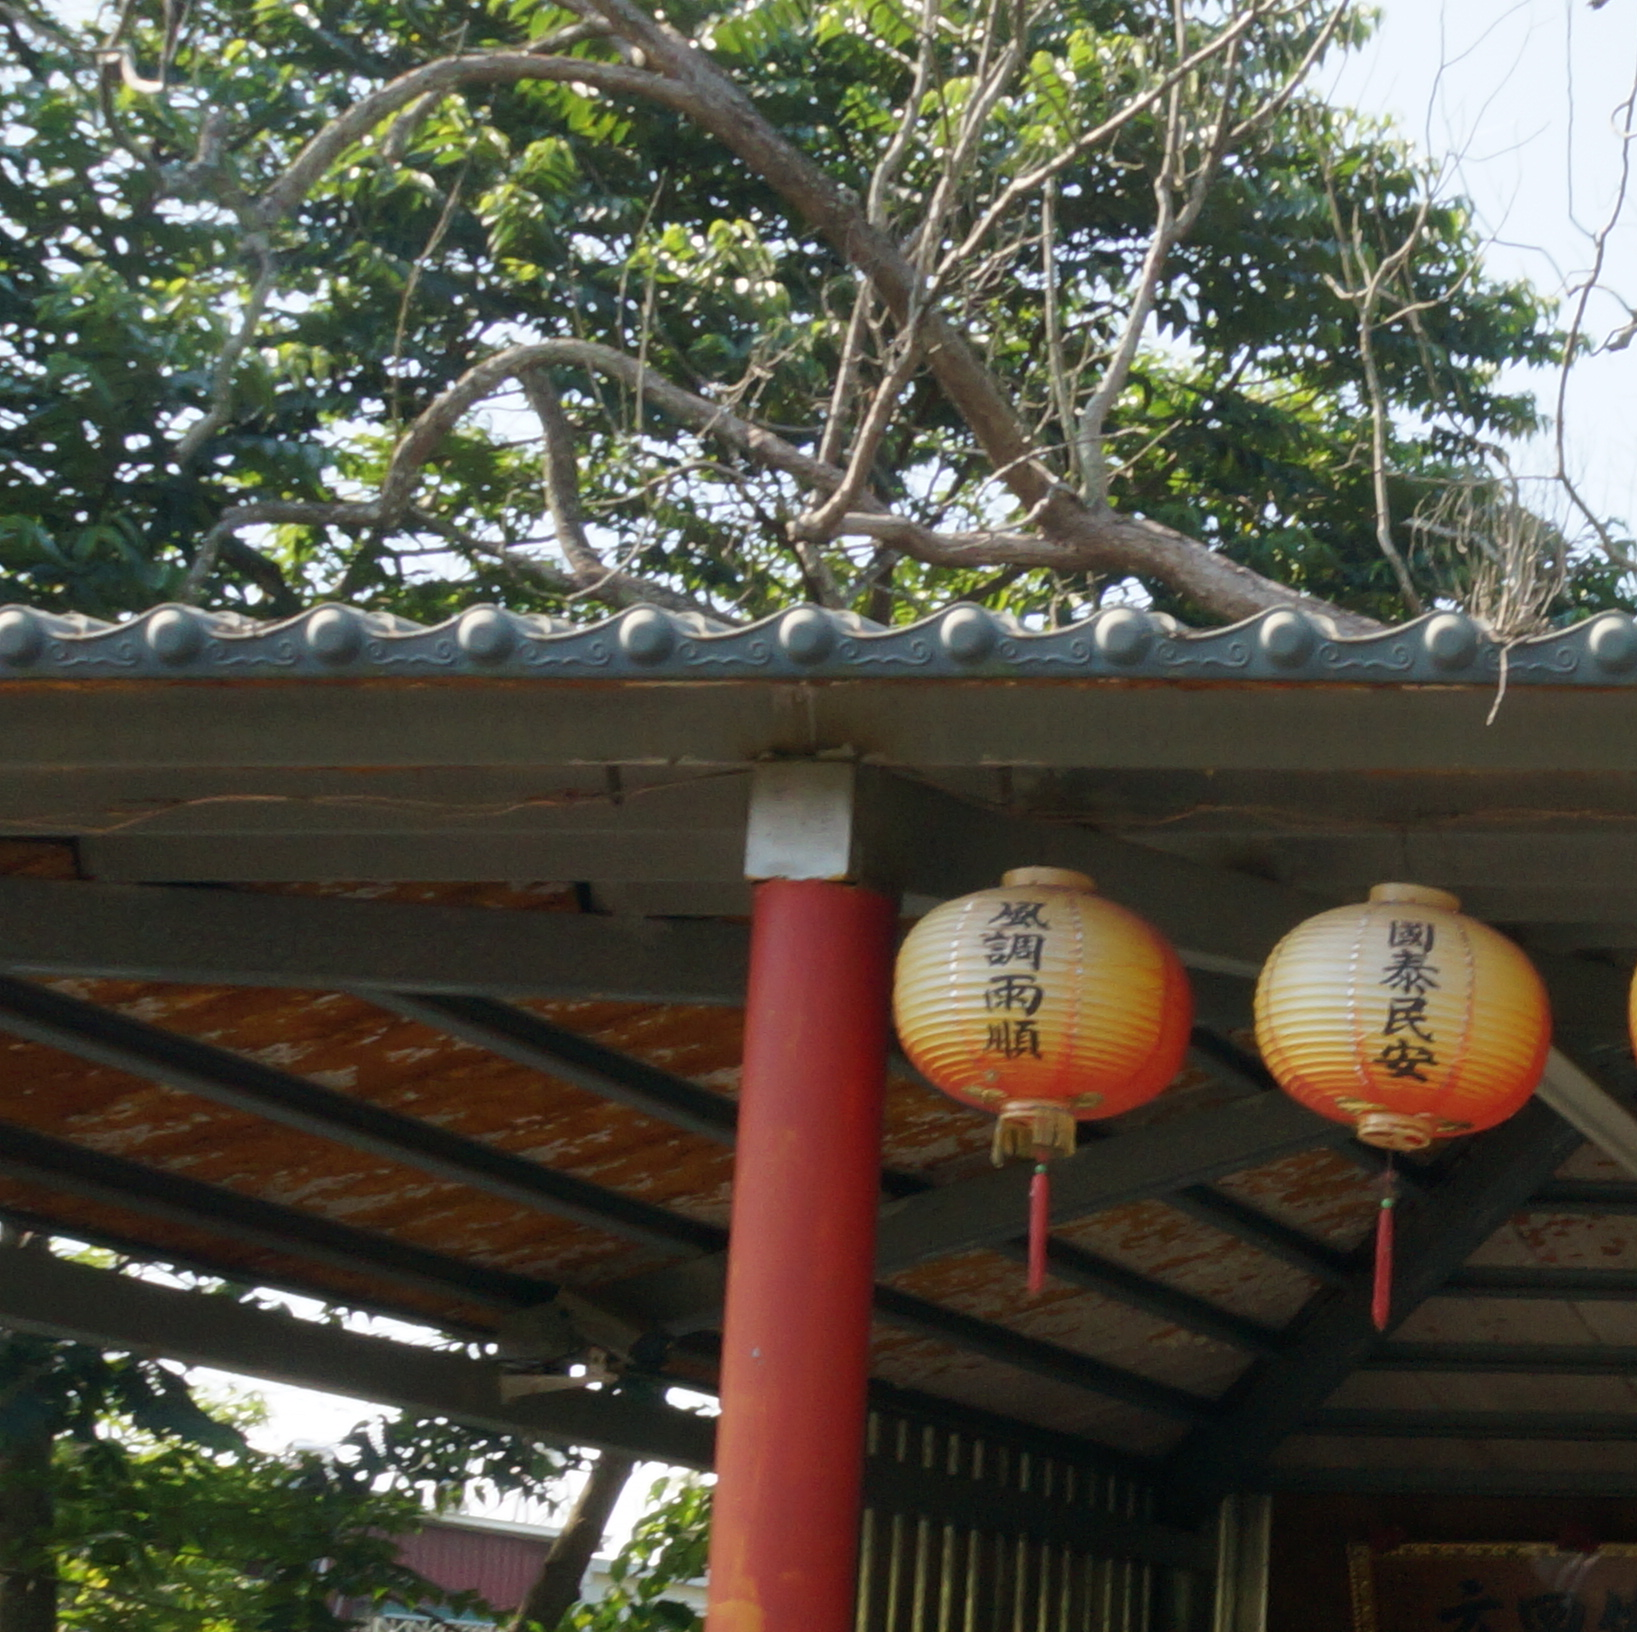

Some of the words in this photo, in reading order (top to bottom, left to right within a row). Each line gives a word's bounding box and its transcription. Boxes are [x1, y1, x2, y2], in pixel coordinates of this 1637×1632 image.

[983, 900, 1050, 1062] 風調雨順
[1374, 917, 1441, 1084] 國泰民安
